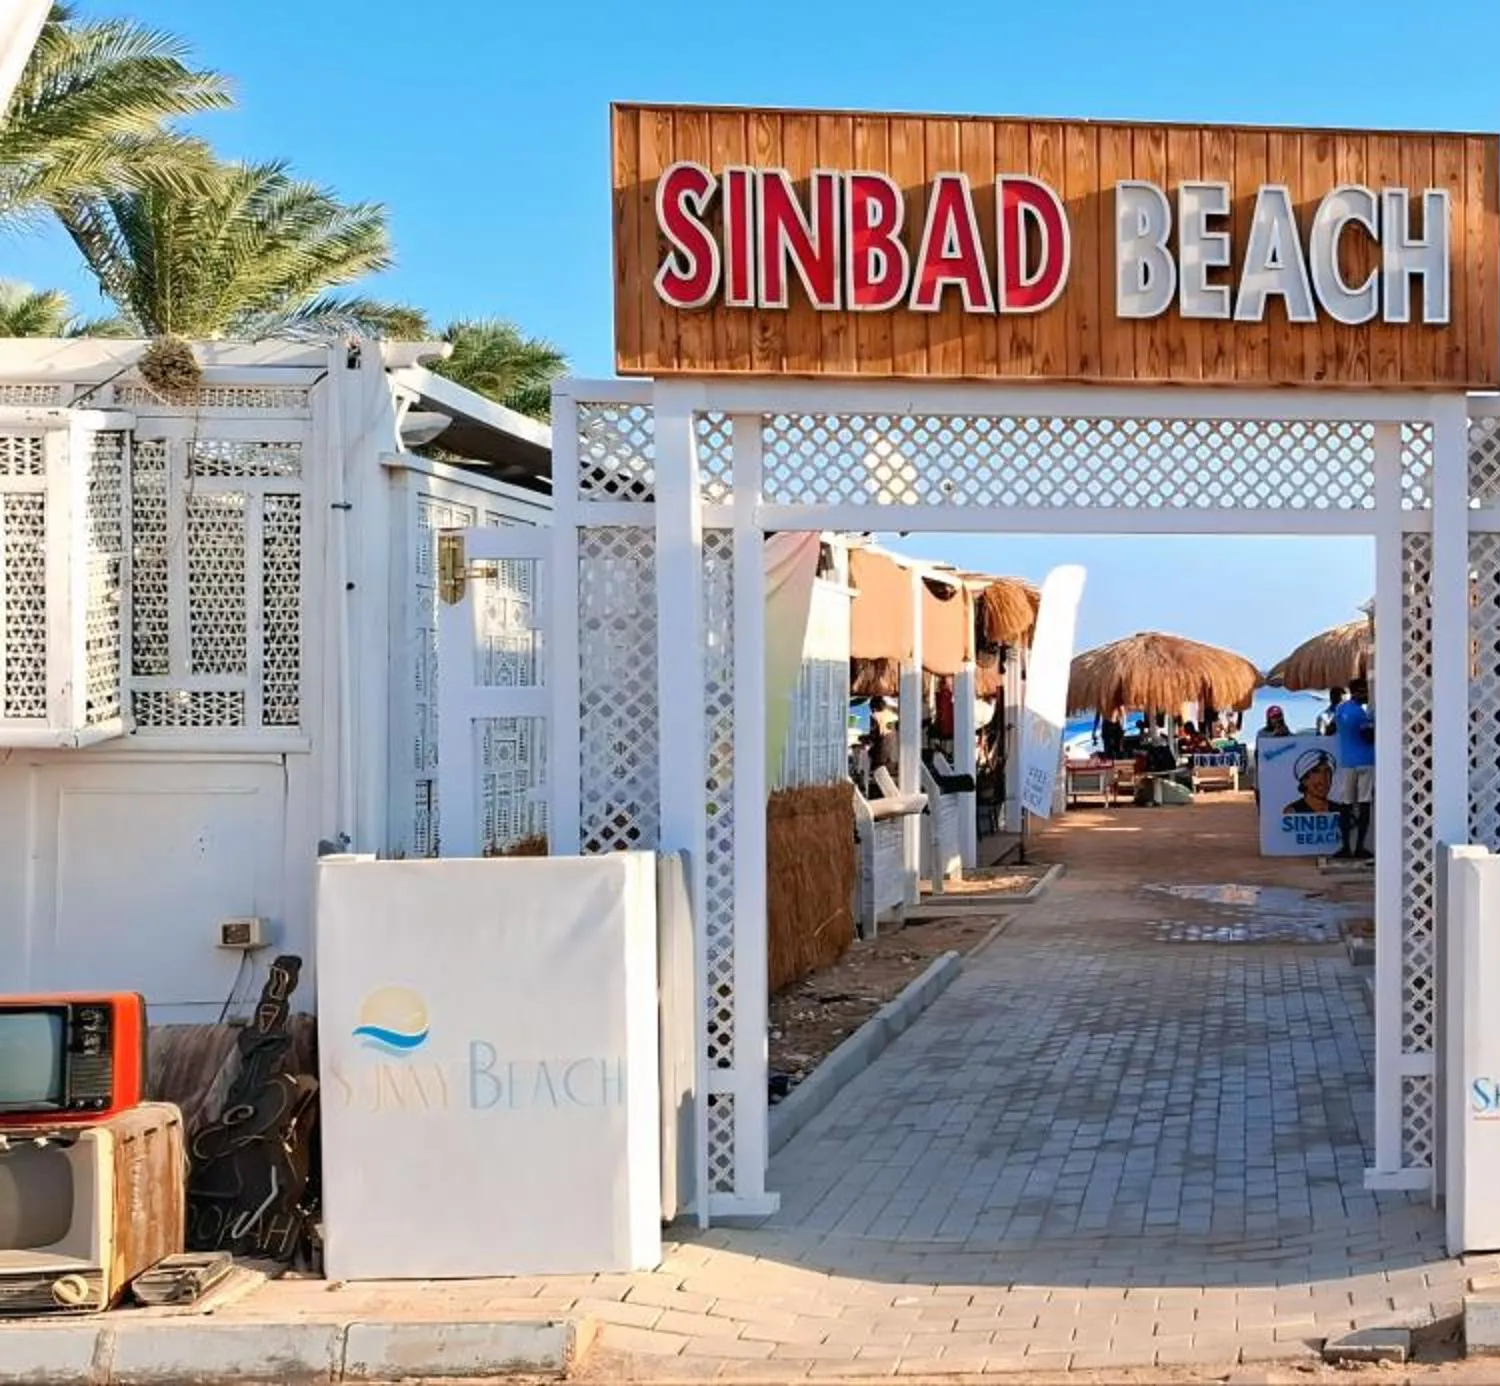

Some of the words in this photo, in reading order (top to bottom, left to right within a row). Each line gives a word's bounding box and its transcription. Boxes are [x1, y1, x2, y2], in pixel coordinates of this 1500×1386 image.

[655, 160, 1071, 314] SINBAD
[1115, 178, 1451, 325] BEACH
[1281, 814, 1342, 832] SINBA
[469, 1040, 625, 1109] BEACH
